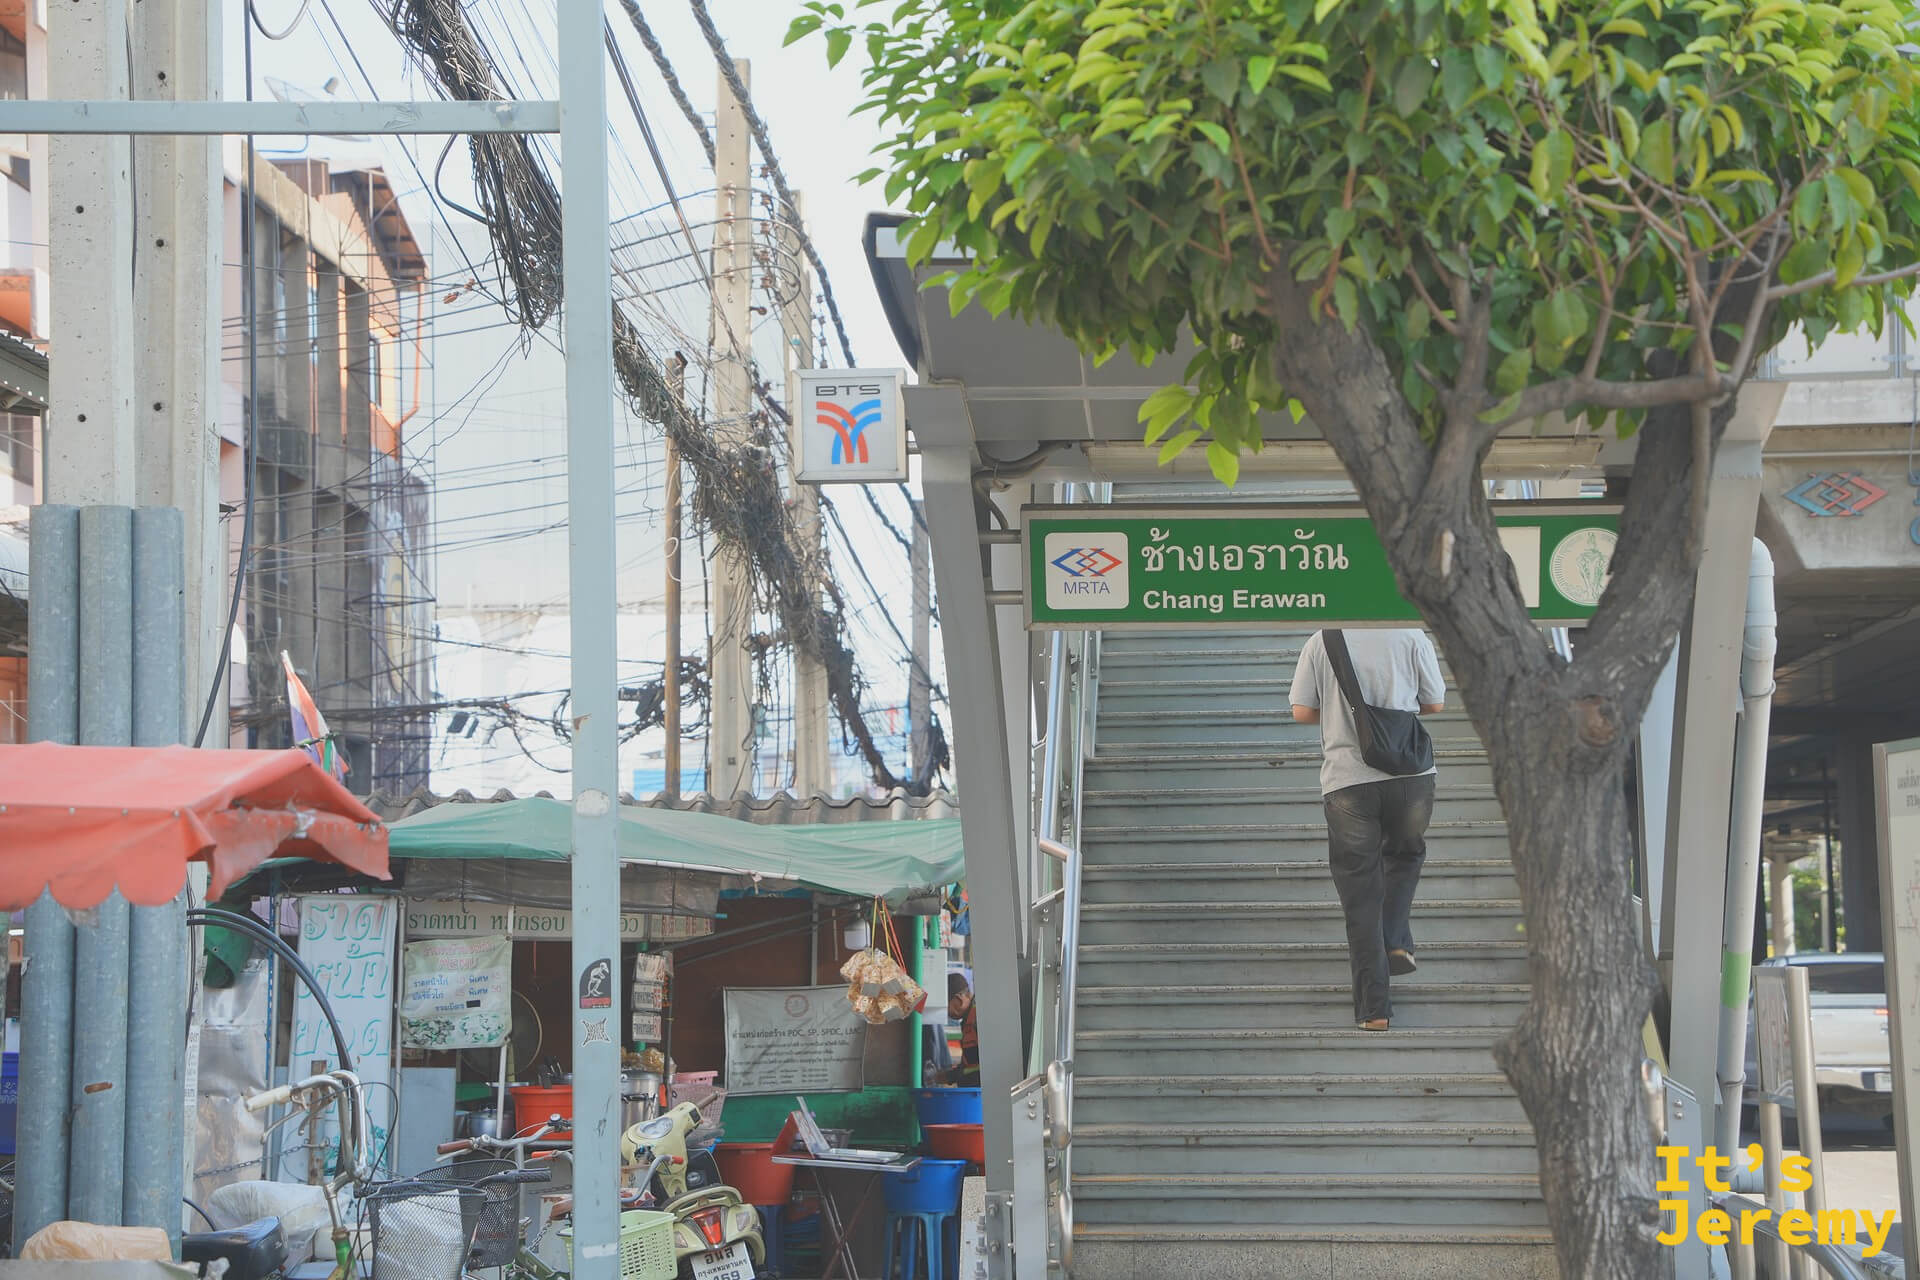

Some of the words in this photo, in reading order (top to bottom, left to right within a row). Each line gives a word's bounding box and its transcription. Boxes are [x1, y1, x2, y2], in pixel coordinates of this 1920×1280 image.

[816, 384, 881, 396] BTS
[1141, 527, 1349, 572] ช้างเอราวัณ
[1064, 581, 1111, 595] MRTA
[1143, 590, 1224, 613] Chang
[1232, 589, 1326, 609] Erawan
[408, 911, 478, 931] ราดหน้า
[698, 1258, 748, 1278] กรุงเทพมหานคร
